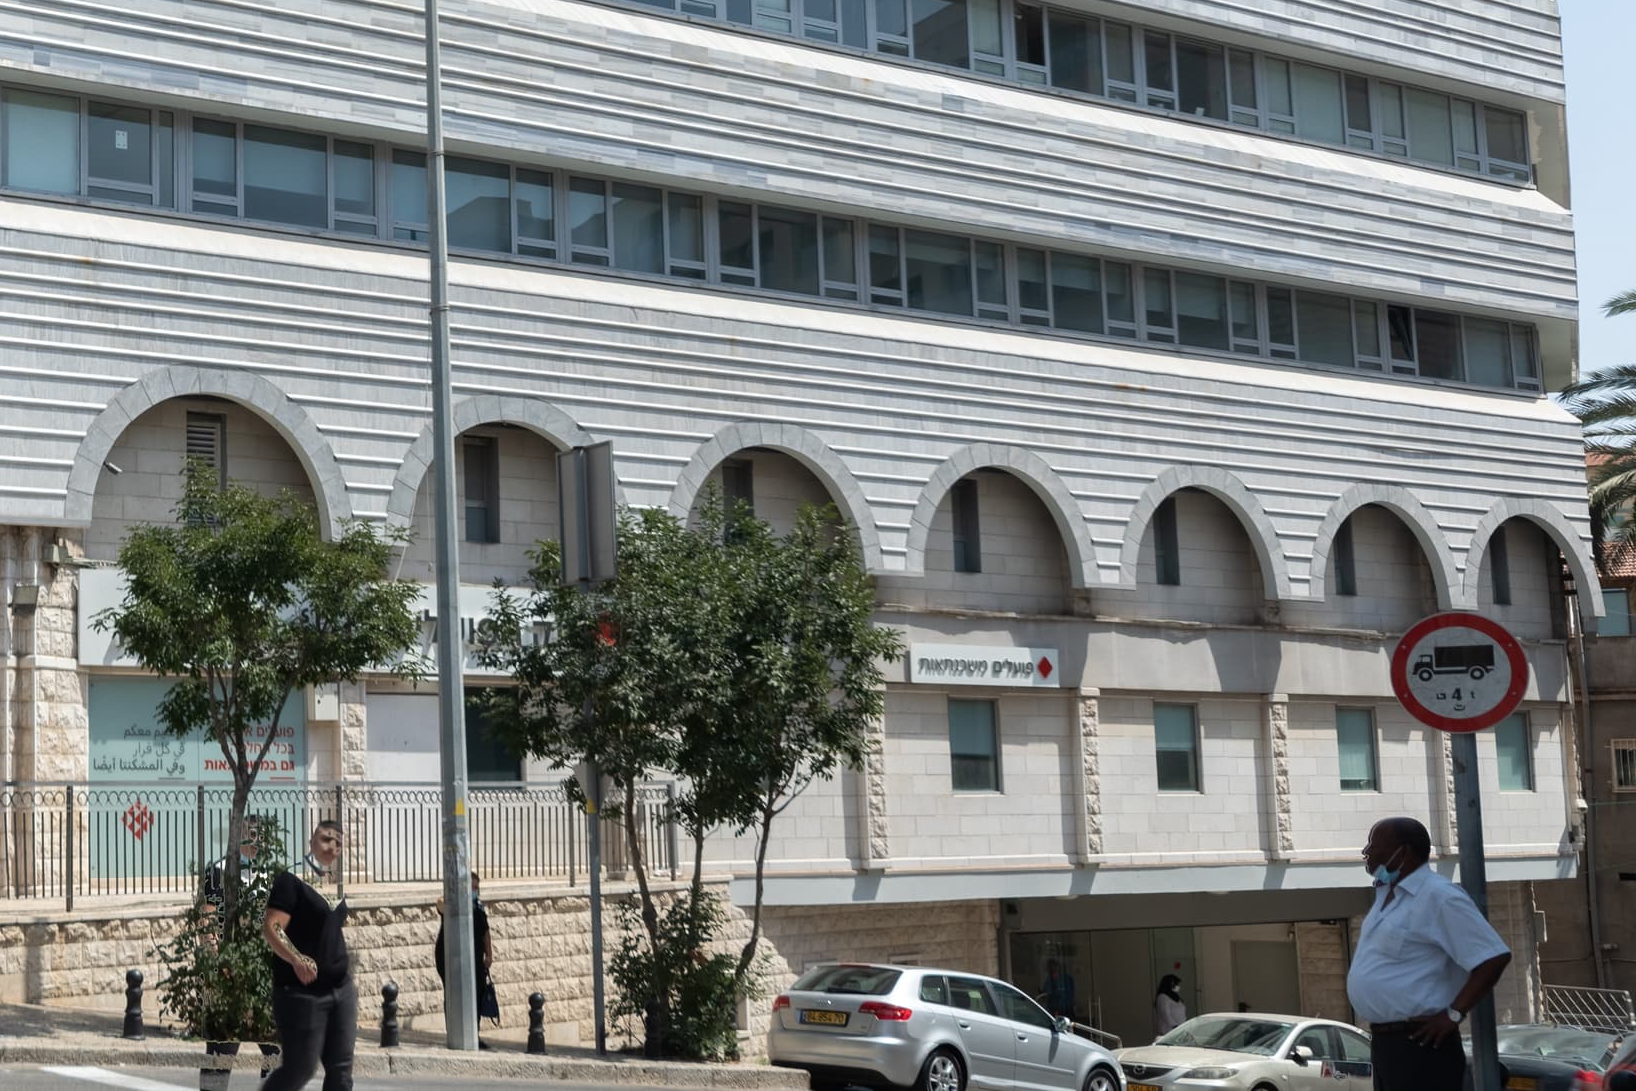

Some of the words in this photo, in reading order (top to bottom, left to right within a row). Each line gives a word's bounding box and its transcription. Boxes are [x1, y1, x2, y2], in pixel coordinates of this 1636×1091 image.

[918, 657, 988, 676] משכנתאות
[991, 658, 1034, 677] פועלים
[1452, 688, 1462, 701] 4
[281, 760, 295, 772] גם
